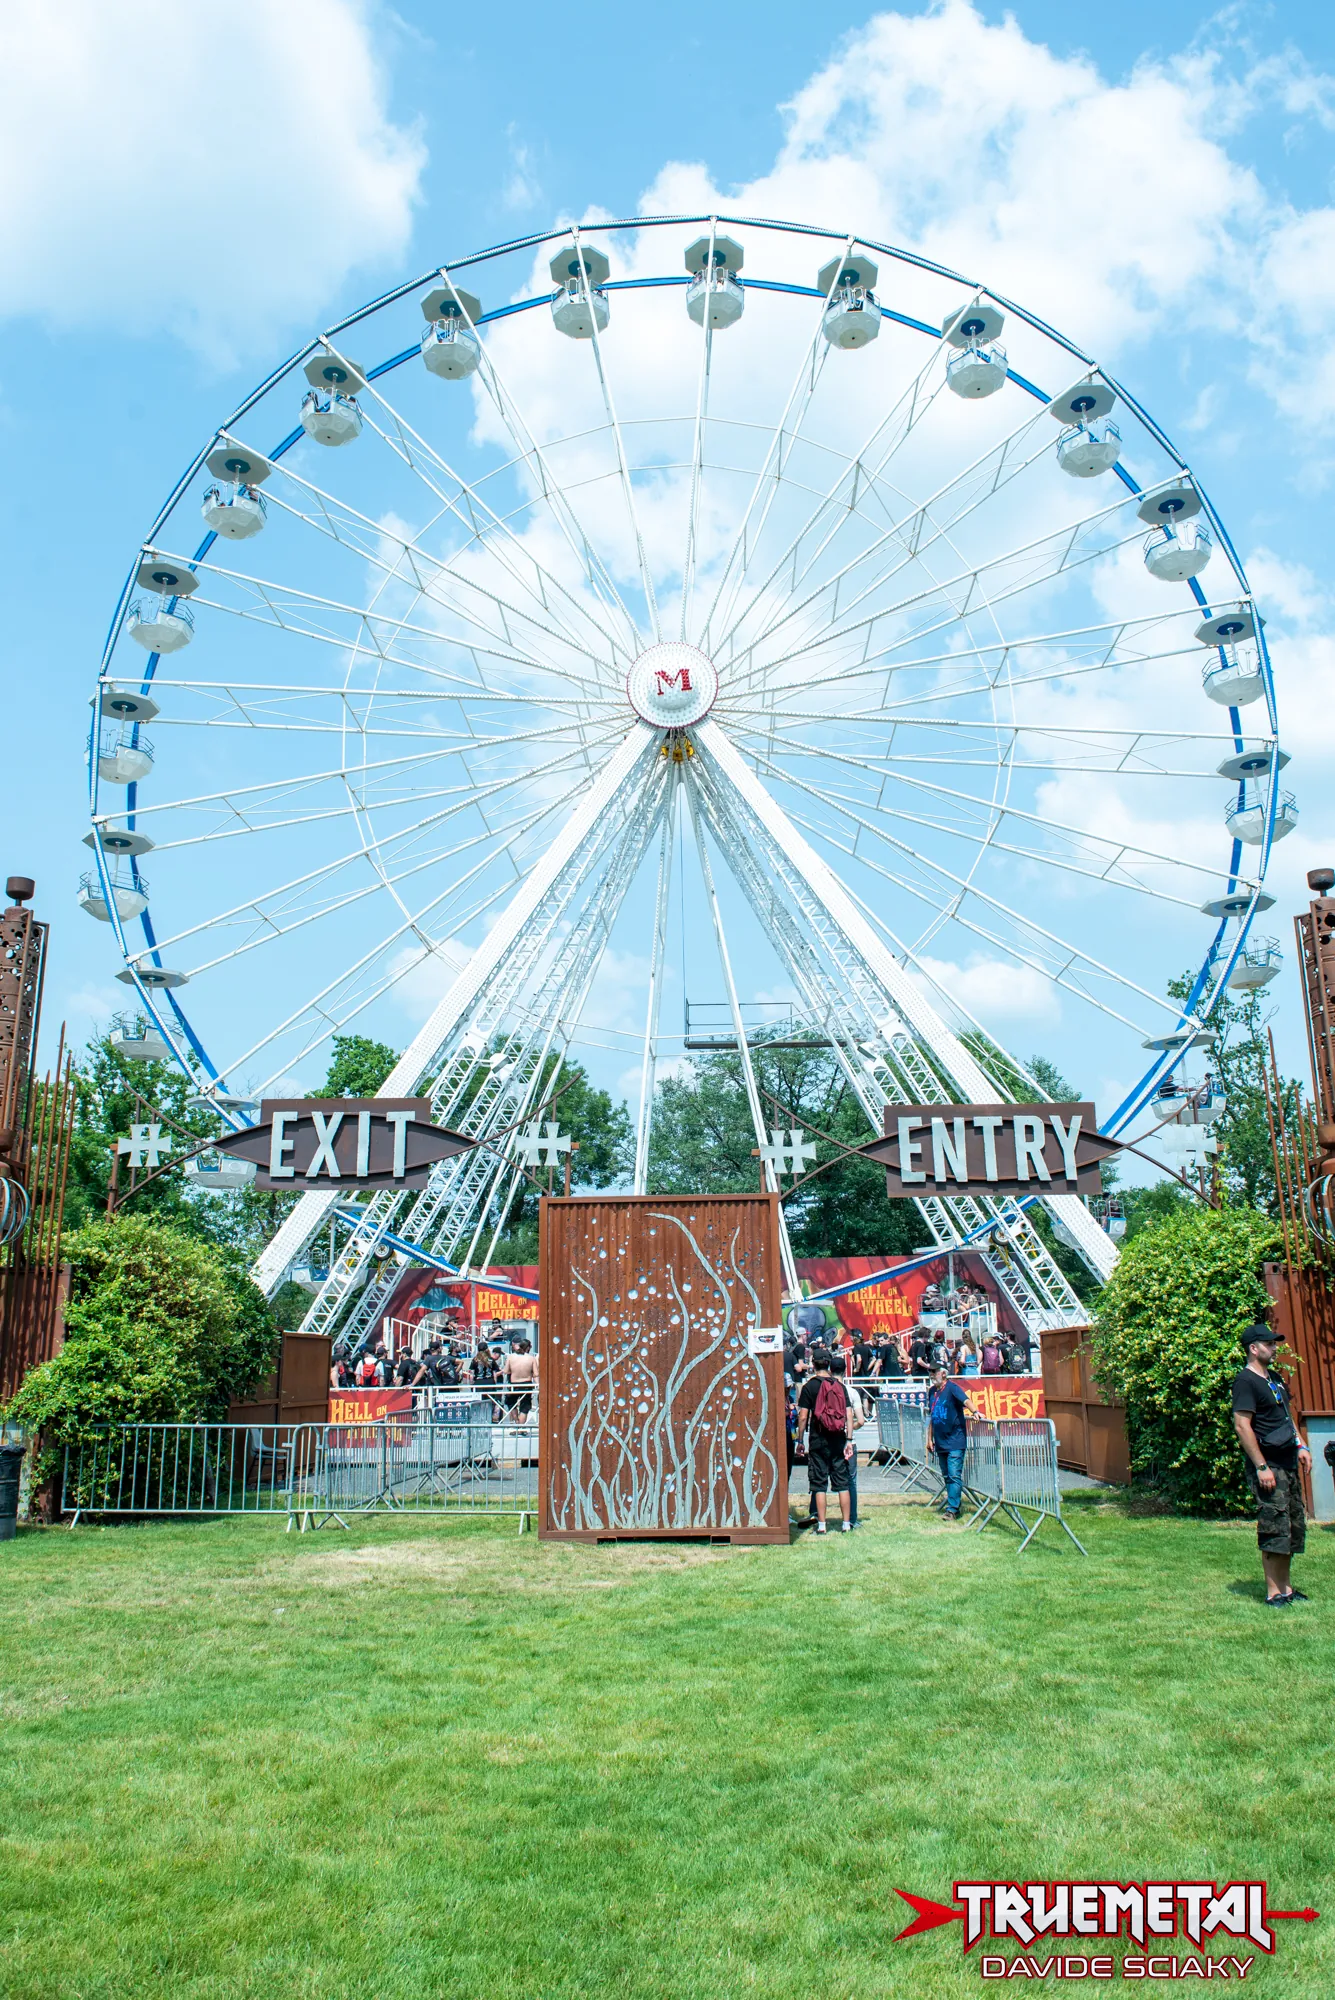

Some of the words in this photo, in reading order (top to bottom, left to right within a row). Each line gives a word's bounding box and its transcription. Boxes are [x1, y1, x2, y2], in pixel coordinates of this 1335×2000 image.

[654, 668, 693, 696] M
[269, 1110, 416, 1178] EXIT
[897, 1115, 1083, 1183] ENTRY
[477, 1291, 515, 1312] HELL
[517, 1297, 528, 1306] ON
[846, 1283, 886, 1303] HELL
[887, 1286, 898, 1297] ON
[861, 1295, 913, 1317] WHEEL
[330, 1399, 373, 1424] HELL
[376, 1405, 388, 1417] ON
